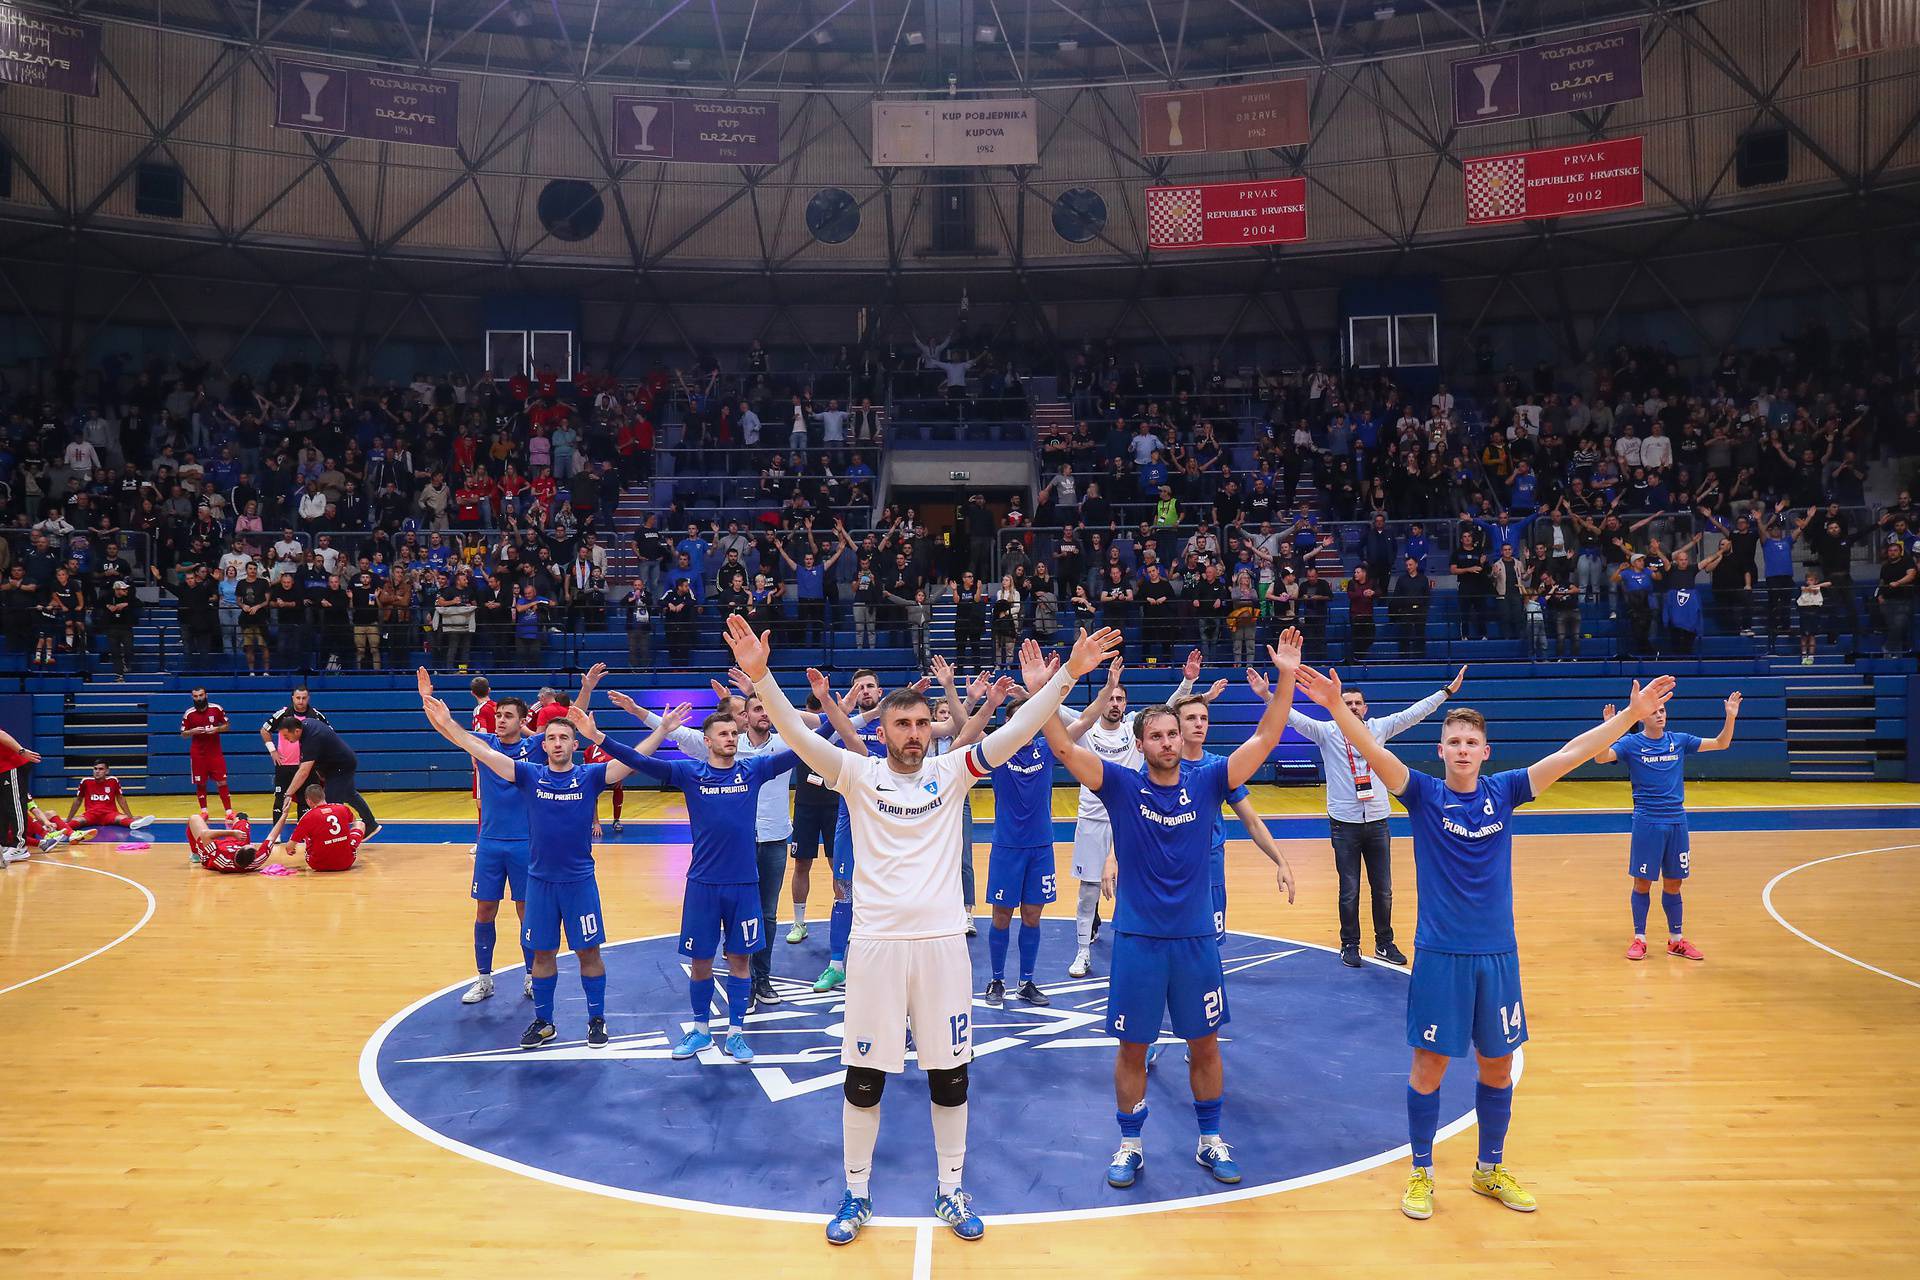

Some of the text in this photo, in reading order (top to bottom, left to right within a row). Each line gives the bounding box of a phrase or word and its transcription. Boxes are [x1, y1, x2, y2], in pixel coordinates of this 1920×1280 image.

[1569, 59, 1594, 71] KUP
[393, 95, 418, 105] KUP
[717, 119, 740, 128] KUP
[942, 111, 1028, 121] KUP POBJEDNIKA
[965, 128, 1005, 137] KUPOVA
[1564, 152, 1605, 165] PRVAK
[1527, 166, 1640, 188] REPUBLIKE HRVATSKE
[1239, 189, 1278, 200] PRVAK
[1567, 190, 1603, 204] 2002
[1207, 204, 1306, 219] REPUBLIKE HRVATSKE
[1243, 225, 1276, 237] 2004
[876, 799, 903, 816] PLAVI
[1140, 804, 1163, 824] PLAVI
[326, 815, 342, 835] 3
[1442, 817, 1468, 838] PLAVI
[580, 913, 598, 937] 10
[741, 917, 760, 944] 17
[1203, 986, 1224, 1020] 21
[1114, 1014, 1127, 1032] d
[1500, 1001, 1522, 1036] 14
[949, 1012, 968, 1046] 12
[1423, 1024, 1438, 1043] d
